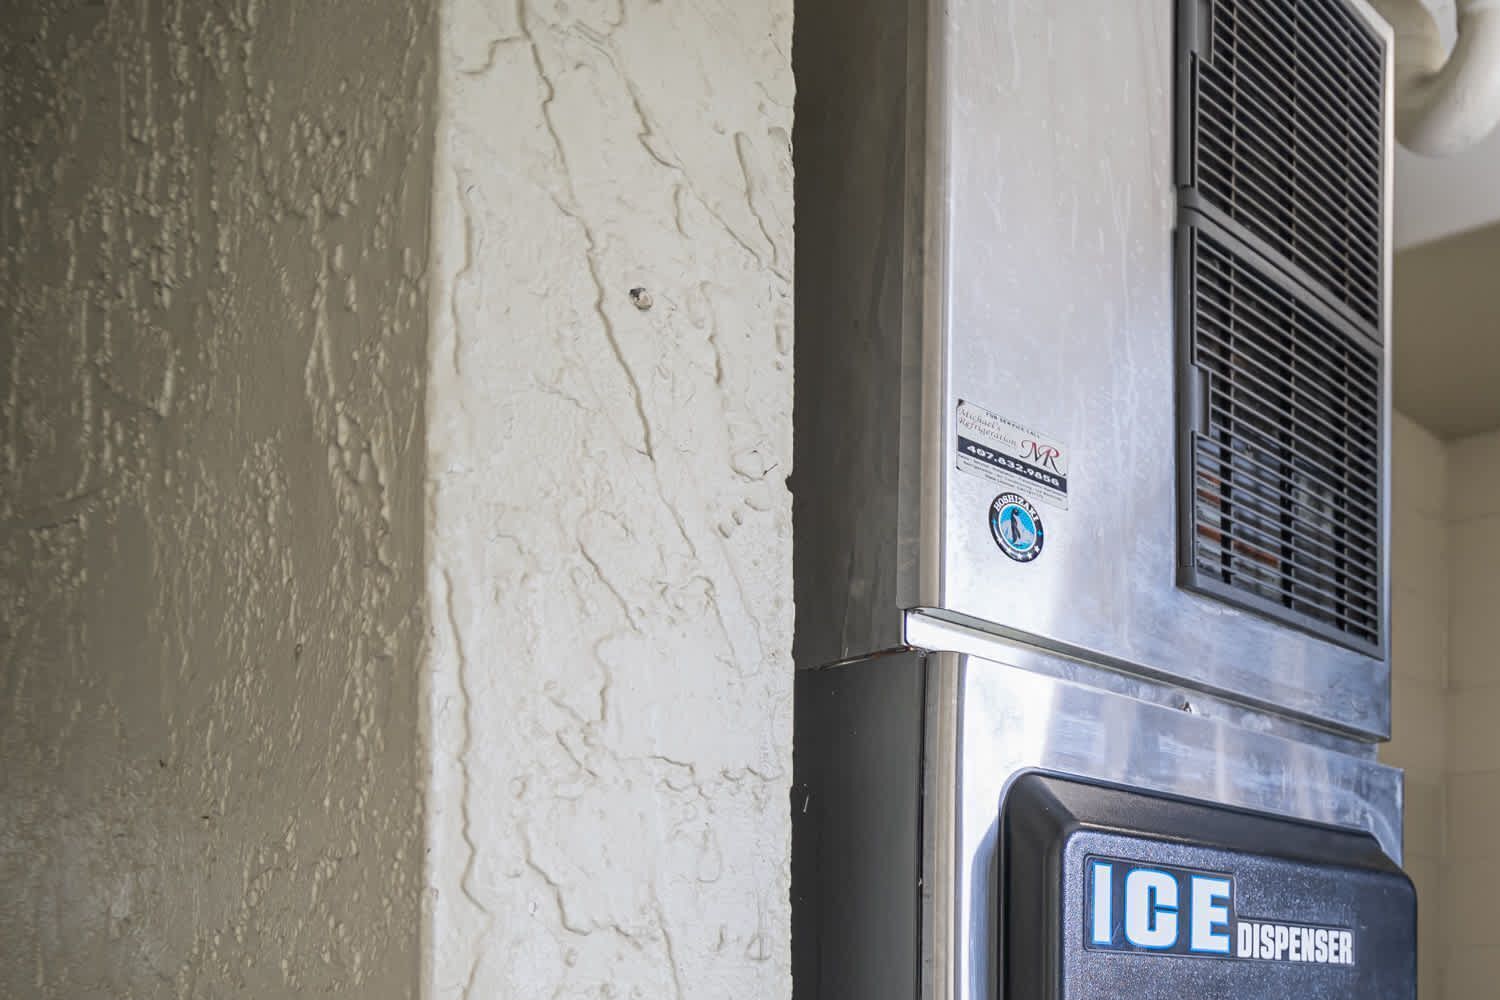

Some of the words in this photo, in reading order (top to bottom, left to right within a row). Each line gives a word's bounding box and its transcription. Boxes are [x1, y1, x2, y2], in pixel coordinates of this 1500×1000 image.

[994, 494, 1039, 522] HOSHIZAKI
[1091, 861, 1232, 954] ICE
[1236, 921, 1355, 966] DISPENSER
